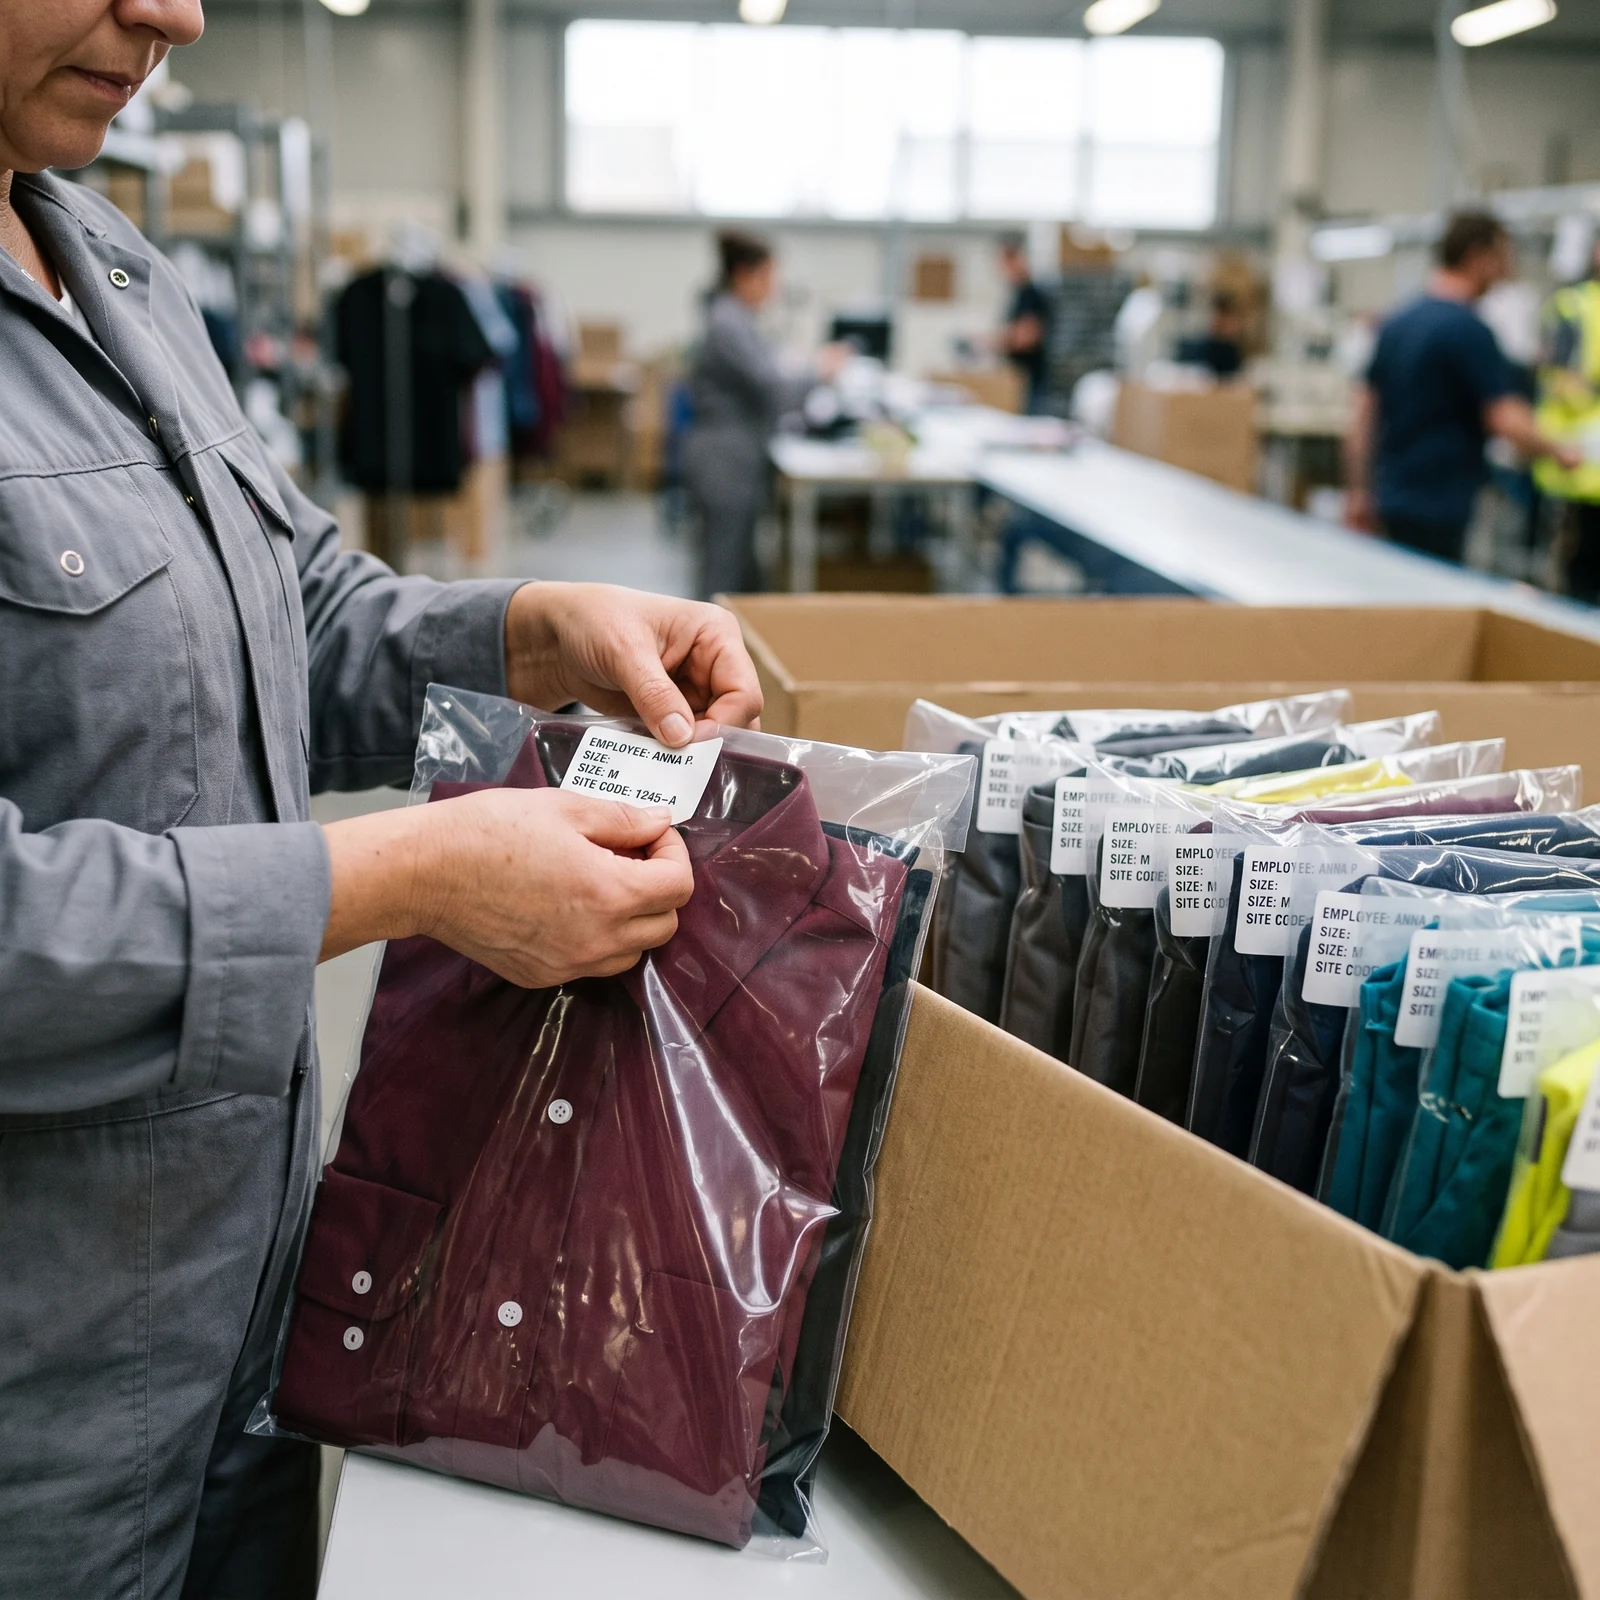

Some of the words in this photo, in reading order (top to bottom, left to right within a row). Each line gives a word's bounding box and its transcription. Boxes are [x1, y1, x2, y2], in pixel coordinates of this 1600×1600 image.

[583, 750, 611, 764] SIZE:
[589, 737, 651, 759] EMPLOYEE:
[652, 751, 682, 765] ANNA
[685, 755, 693, 765] P.
[577, 762, 606, 776] SIZE:
[607, 769, 620, 780] M
[572, 775, 598, 789] SITE
[599, 781, 632, 797] CODE:
[635, 788, 677, 806] 1245-A
[1112, 821, 1171, 834] EMPLOYEE:
[1060, 837, 1082, 848] SITE
[1111, 838, 1137, 849] SIZE:
[1110, 853, 1137, 865] SIZE:
[1140, 854, 1150, 865] M
[1175, 865, 1204, 876] SIZE:
[1251, 860, 1315, 874] EMPLOYEE:
[1318, 862, 1347, 875] ANNA
[1109, 869, 1133, 881] SITE
[1136, 870, 1168, 882] CODE:
[1175, 880, 1203, 892] SIZE:
[1249, 878, 1278, 891] SIZE:
[1175, 897, 1200, 909] SITE
[1203, 897, 1229, 909] COD
[1247, 895, 1277, 908] SIZE:
[1280, 896, 1291, 908] M
[1246, 912, 1271, 925] SITE
[1322, 906, 1390, 925] EMPLOYEE:
[1320, 926, 1351, 940] SIZE:
[1317, 943, 1348, 957] SIZE:
[1315, 960, 1342, 975] SITE
